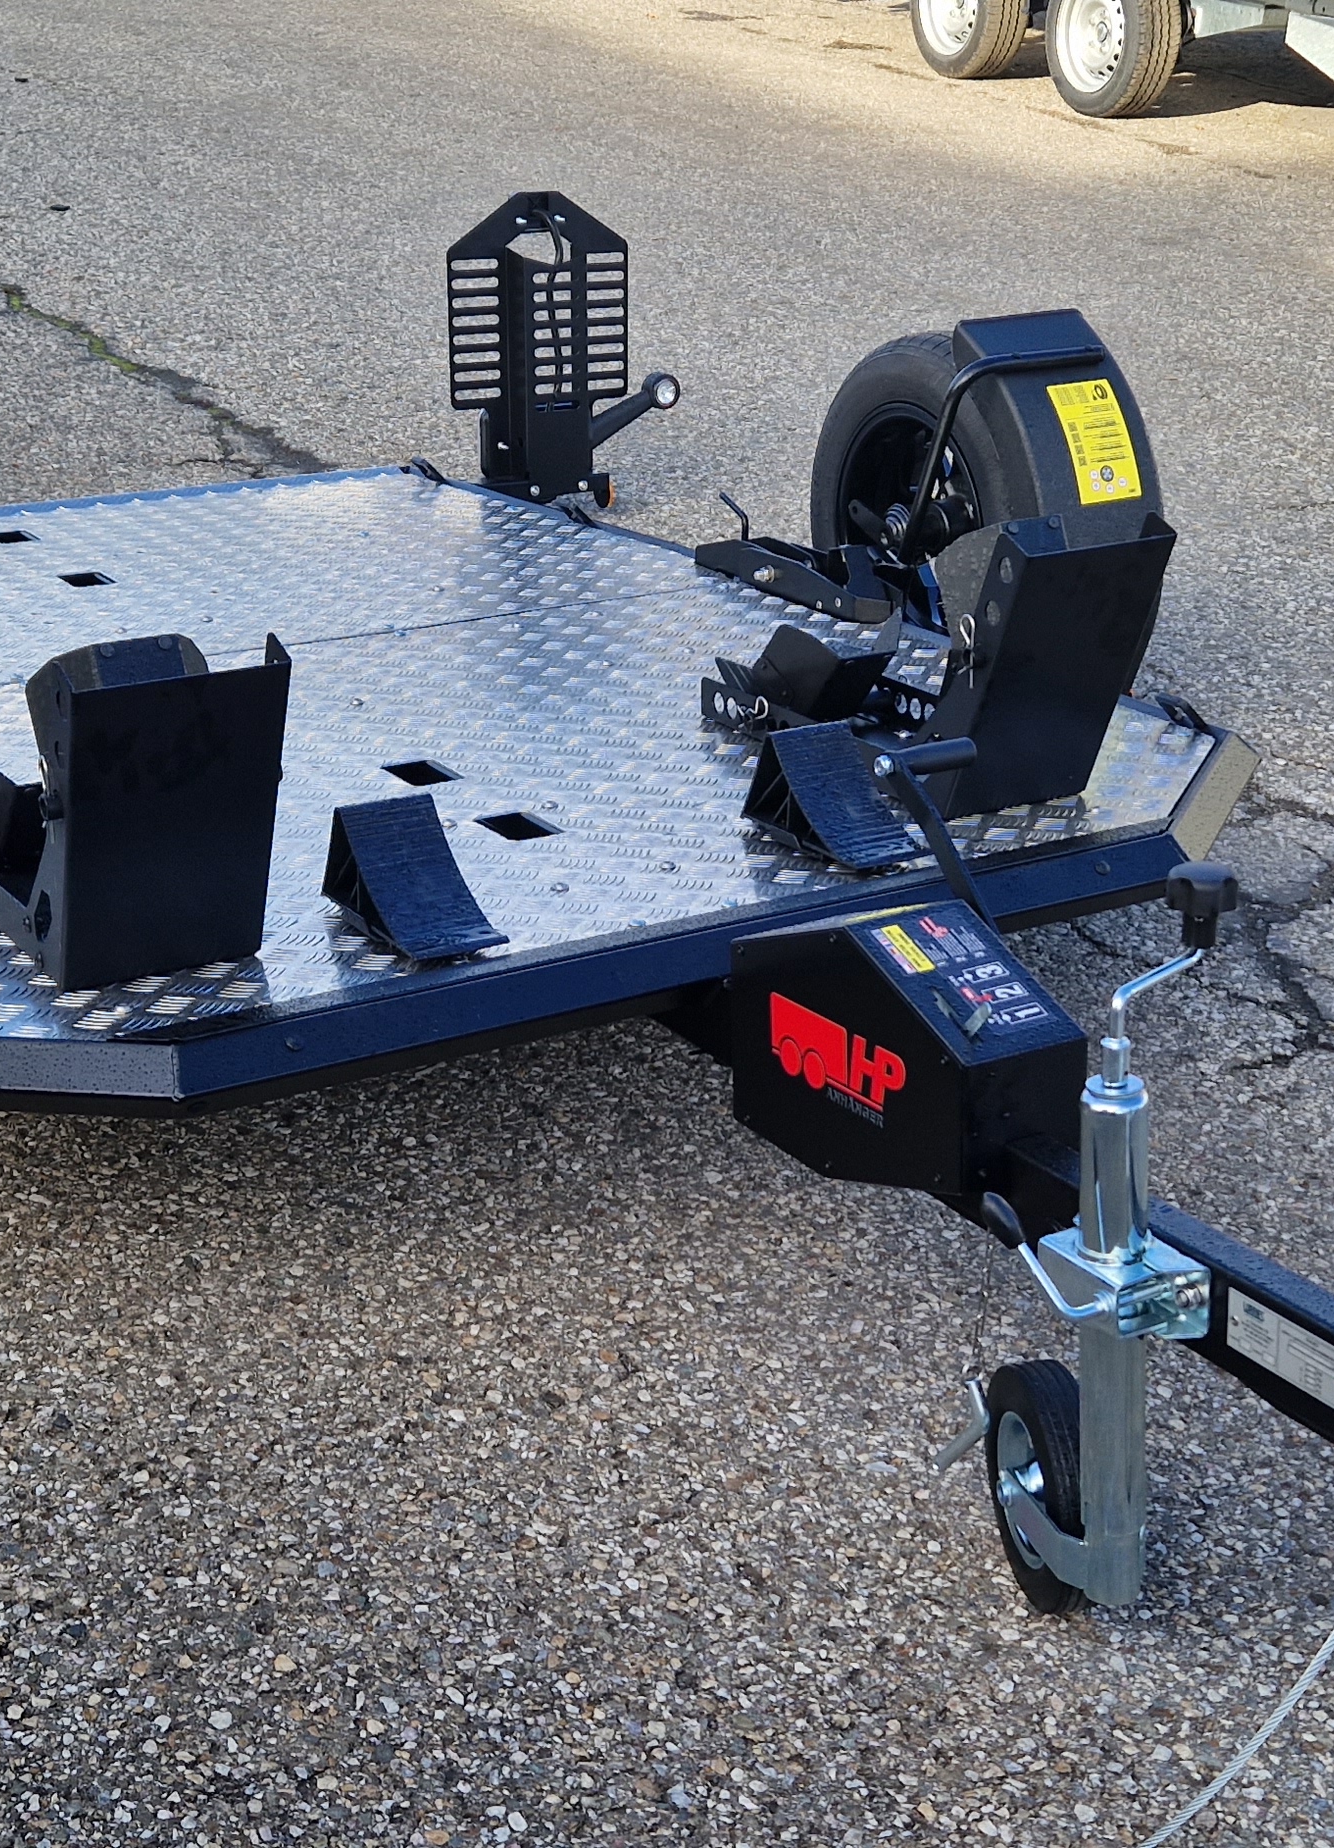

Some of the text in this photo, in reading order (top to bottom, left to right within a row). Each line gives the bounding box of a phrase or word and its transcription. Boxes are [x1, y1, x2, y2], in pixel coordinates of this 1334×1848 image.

[975, 964, 1004, 979] 3
[995, 984, 1023, 999] 2
[1014, 1006, 1041, 1019] 1
[849, 1034, 907, 1106] HP
